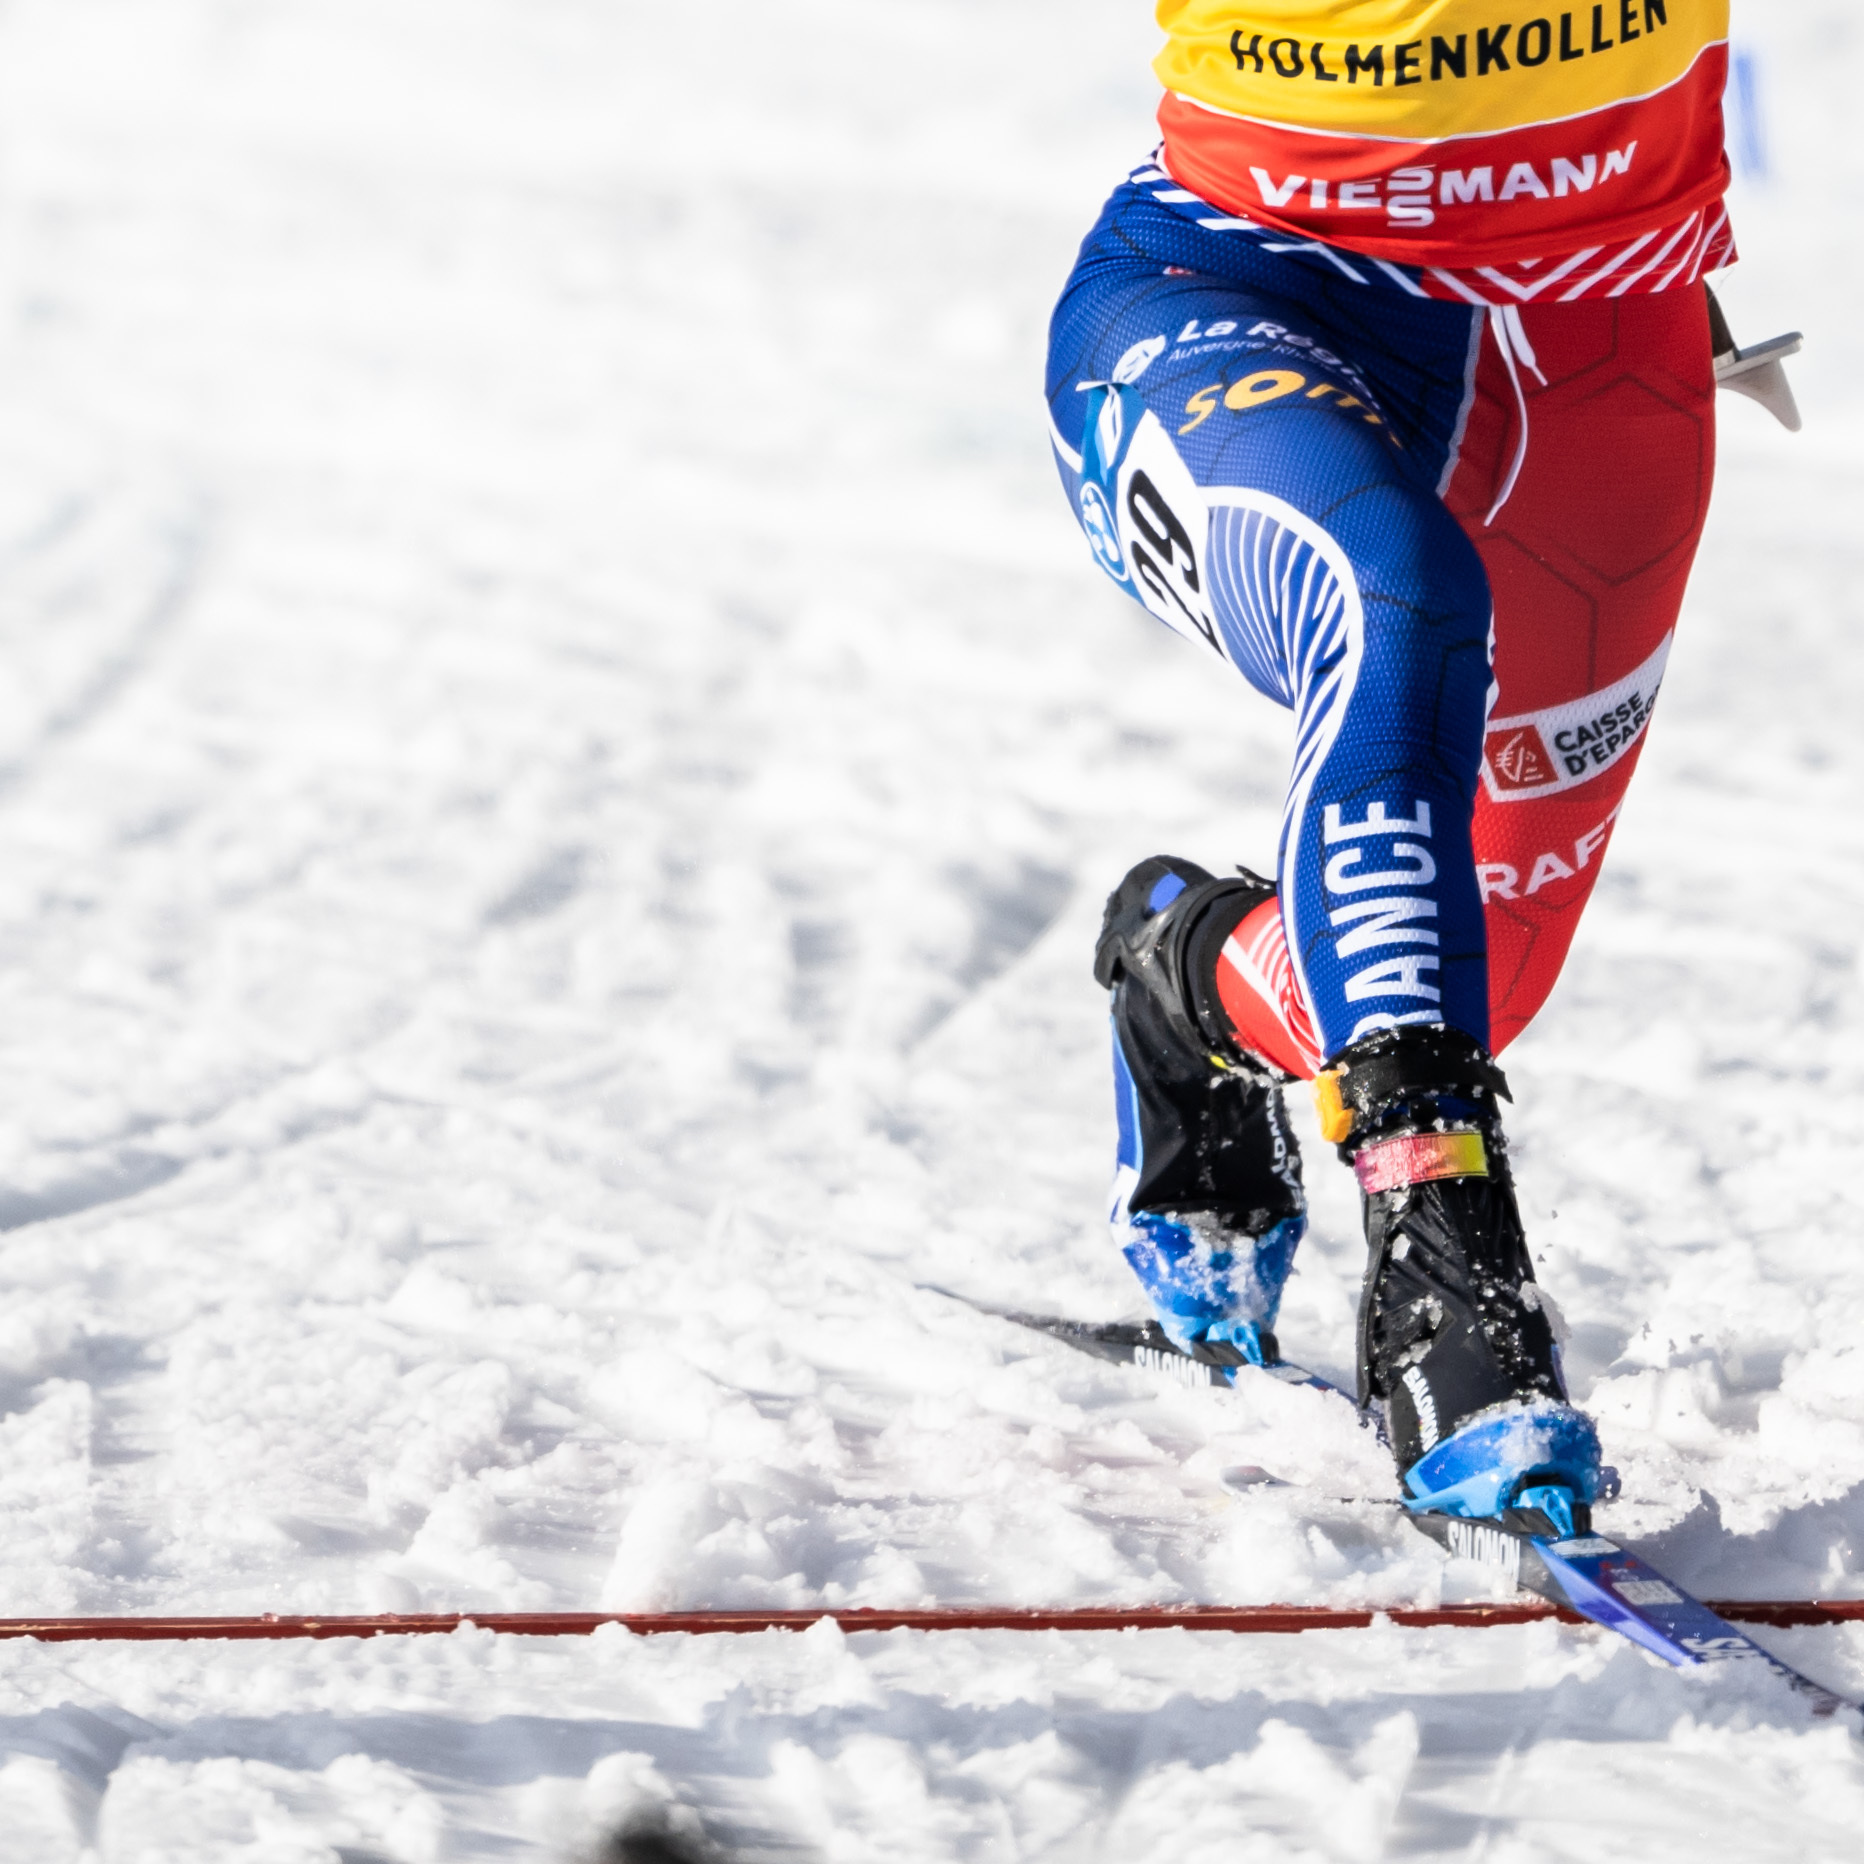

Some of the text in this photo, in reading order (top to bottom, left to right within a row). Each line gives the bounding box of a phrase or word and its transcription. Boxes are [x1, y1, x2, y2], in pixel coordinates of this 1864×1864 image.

[1248, 140, 1638, 228] VIESSMANN
[1177, 319, 1238, 343] La
[1127, 468, 1230, 664] 29
[1554, 691, 1643, 753] CAISSE
[1402, 1365, 1439, 1453] SALOMON
